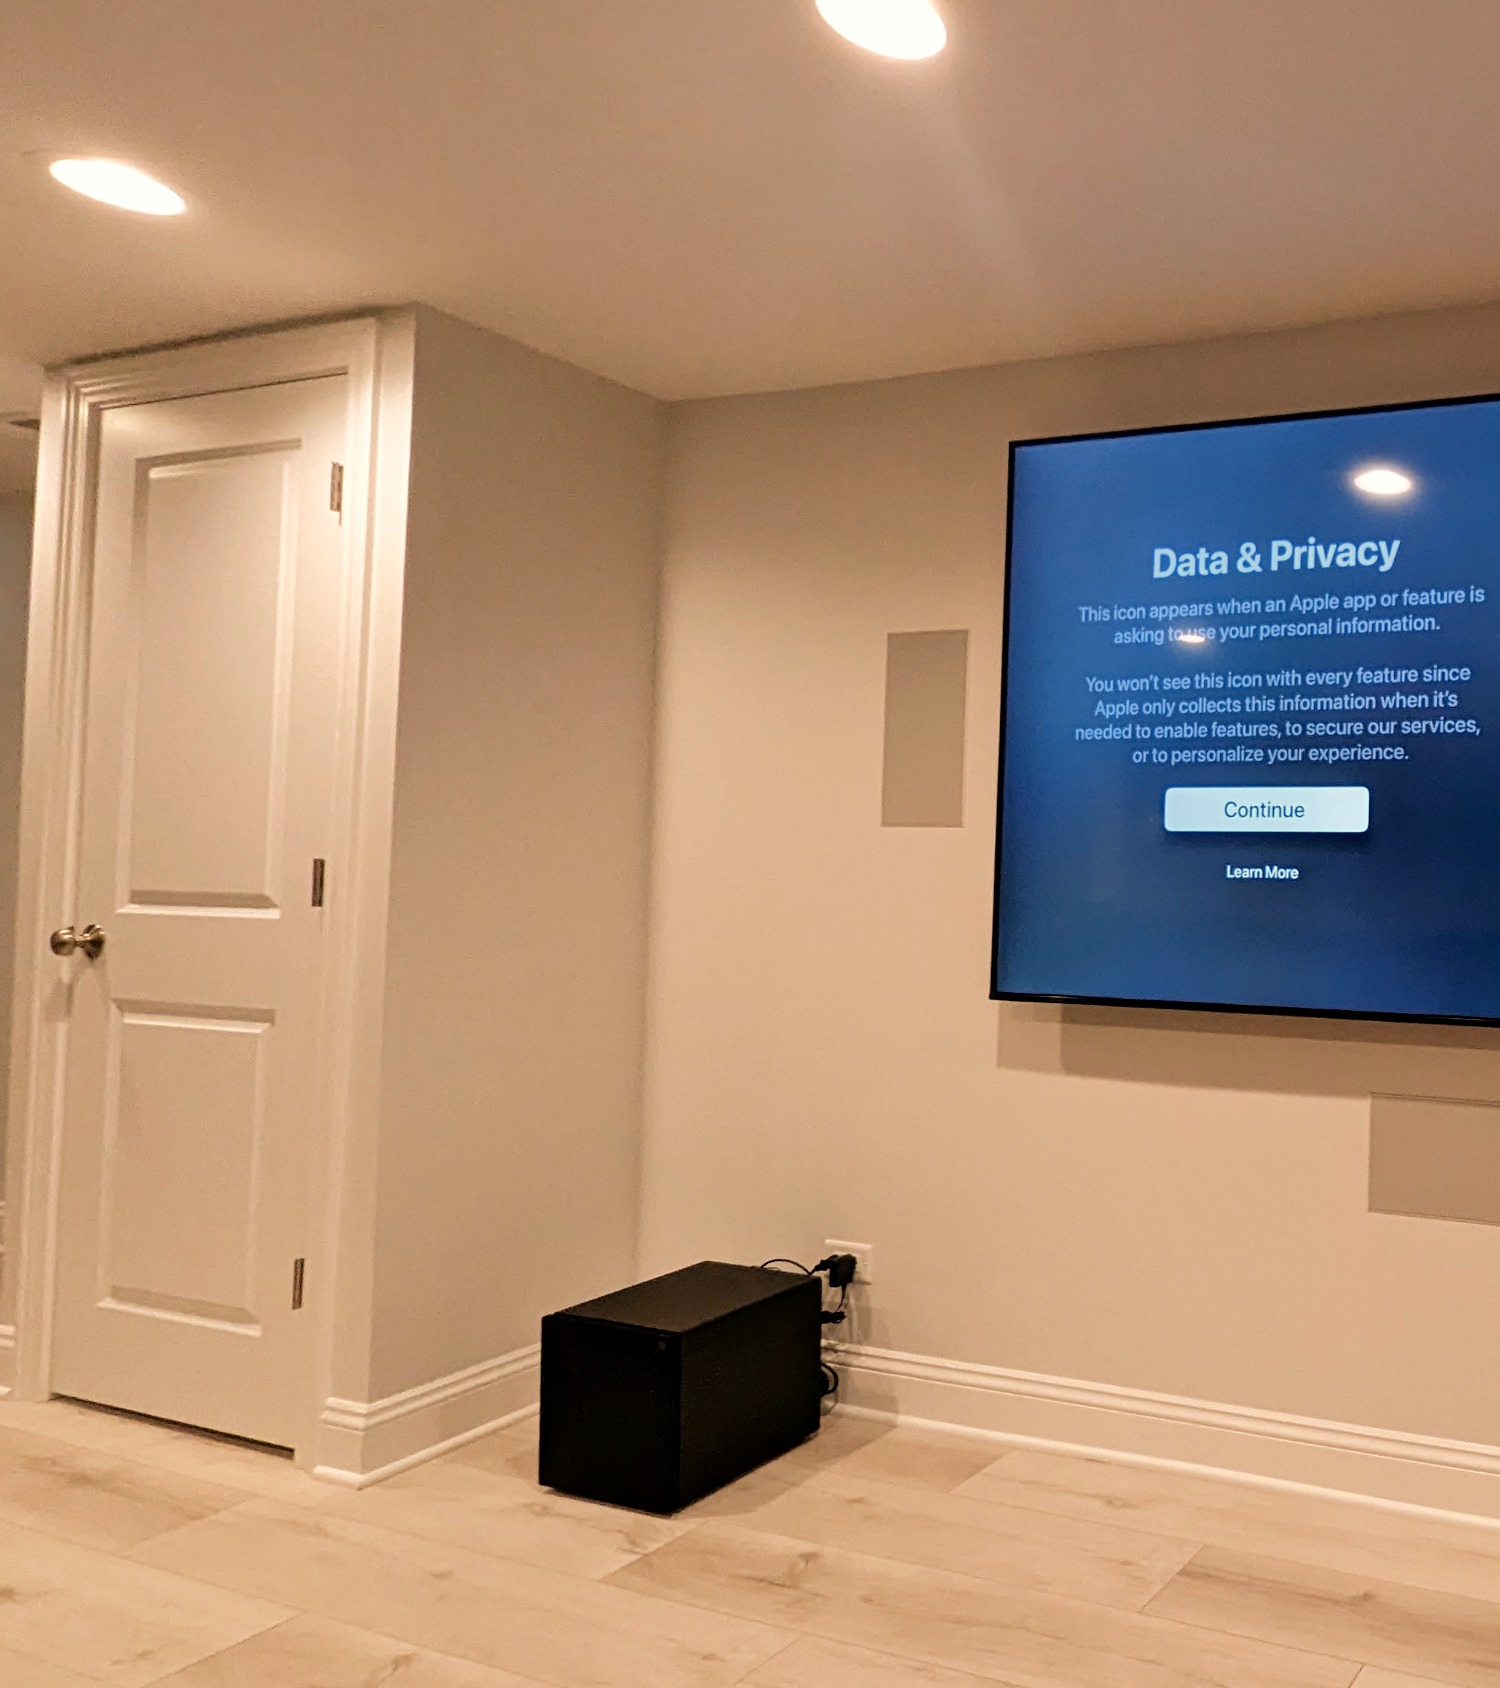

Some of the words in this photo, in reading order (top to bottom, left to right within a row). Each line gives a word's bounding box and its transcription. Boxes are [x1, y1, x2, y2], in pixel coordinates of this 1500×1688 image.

[1152, 546, 1228, 579] Data
[1236, 542, 1262, 573] &
[1270, 536, 1401, 572] Privacy
[1079, 605, 1110, 622] This
[1113, 604, 1146, 620] icon
[1149, 601, 1213, 620] appears
[1217, 599, 1262, 615] when
[1265, 599, 1286, 612] an
[1290, 593, 1339, 613] Apple
[1343, 593, 1376, 610] app
[1380, 592, 1399, 606] or
[1402, 587, 1465, 605] feature
[1469, 585, 1485, 601] is
[1113, 626, 1164, 646] asking
[1168, 626, 1184, 641] to
[1220, 625, 1256, 641] your
[1259, 618, 1332, 640] personal
[1336, 614, 1440, 635] information.
[1086, 675, 1113, 692] You
[1116, 674, 1159, 690] won't
[1163, 674, 1190, 689] see
[1194, 672, 1224, 688] this
[1227, 671, 1262, 687] icon
[1266, 669, 1301, 686] with
[1305, 668, 1352, 689] every
[1356, 666, 1418, 683] feature
[1422, 665, 1471, 681] since
[1094, 699, 1138, 719] Apple
[1142, 697, 1174, 716] only
[1179, 695, 1241, 714] collects
[1245, 694, 1275, 711] this
[1279, 692, 1376, 710] information
[1380, 691, 1428, 708] when
[1432, 690, 1457, 707] it's
[1075, 723, 1131, 741] needed
[1135, 723, 1151, 739] to
[1154, 721, 1207, 738] enable
[1211, 720, 1281, 740] features,
[1285, 721, 1302, 736] to
[1306, 720, 1363, 736] secure
[1367, 720, 1397, 735] our
[1401, 718, 1481, 736] services,
[1132, 749, 1148, 763] or
[1152, 748, 1167, 762] to
[1170, 746, 1263, 765] personalize
[1267, 747, 1304, 763] your
[1308, 744, 1409, 764] experience.
[1224, 801, 1305, 819] Continue
[1226, 865, 1262, 879] Learn
[1265, 865, 1299, 879] More
